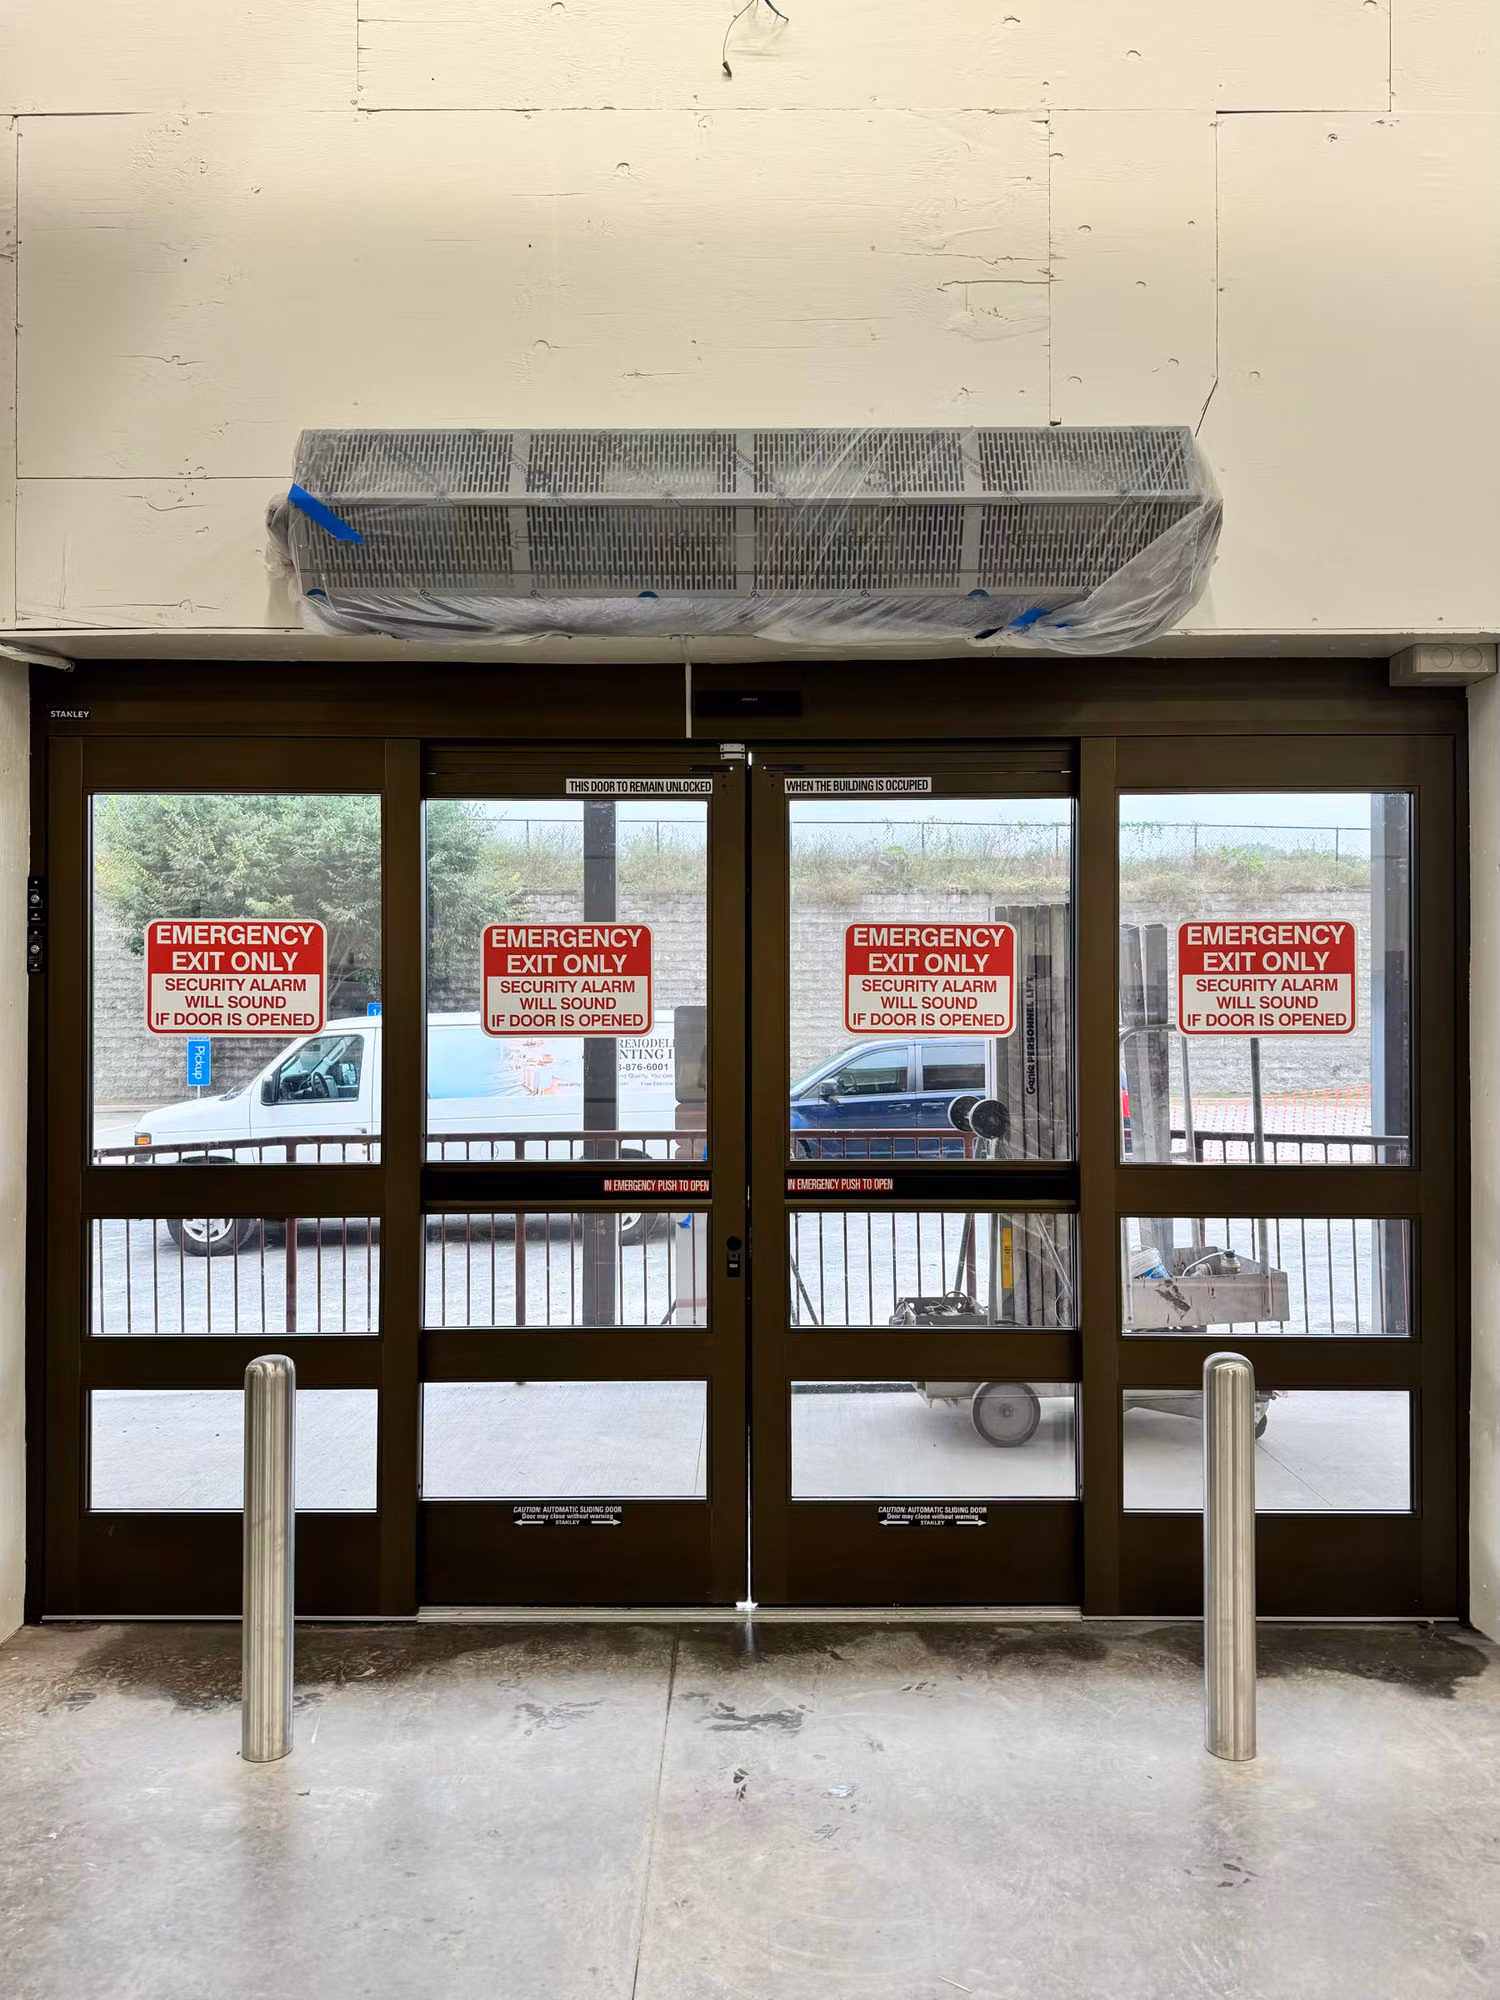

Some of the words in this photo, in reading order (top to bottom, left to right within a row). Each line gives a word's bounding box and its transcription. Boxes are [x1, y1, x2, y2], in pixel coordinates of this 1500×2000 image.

[50, 710, 90, 718] STANLEY
[569, 781, 589, 792] THIS
[591, 781, 615, 792] DOOR
[617, 781, 628, 792] TO
[630, 781, 665, 792] REMAIN
[666, 781, 712, 792] UNLOCKED
[786, 781, 813, 792] WHEN
[815, 780, 832, 791] THE
[833, 780, 874, 791] BUILDING
[875, 780, 884, 791] IS
[885, 779, 928, 790] OCCUPIED
[157, 925, 314, 945] EMERGENCY
[492, 929, 642, 947] EMERGENCY
[854, 928, 1004, 947] EMERGENCY
[1188, 925, 1345, 945] EMERGENCY
[173, 952, 224, 970] EXIT
[231, 952, 298, 971] ONLY
[508, 955, 557, 973] EXIT
[564, 954, 627, 973] ONLY
[869, 953, 919, 972] EXIT
[925, 954, 989, 972] ONLY
[1204, 952, 1256, 971] EXIT
[1263, 952, 1329, 971] ONLY
[165, 978, 245, 991] SECURITY
[249, 979, 306, 991] ALARM
[501, 981, 577, 993] SECURITY
[581, 980, 635, 993] ALARM
[862, 979, 938, 992] SECURITY
[942, 980, 996, 992] ALARM
[1197, 979, 1277, 992] SECURITY
[1281, 979, 1337, 991] ALARM
[185, 996, 224, 1008] WILL
[228, 996, 286, 1008] SOUND
[520, 998, 557, 1010] WILL
[561, 997, 616, 1010] SOUND
[881, 997, 918, 1009] WILL
[922, 997, 977, 1009] SOUND
[1216, 996, 1256, 1009] WILL
[1260, 996, 1318, 1009] SOUND
[156, 1013, 169, 1025] IF
[174, 1013, 222, 1025] DOOR
[228, 1013, 242, 1026] IS
[247, 1013, 314, 1026] OPENED
[492, 1015, 505, 1027] IF
[510, 1014, 555, 1027] DOOR
[561, 1014, 574, 1026] IS
[579, 1014, 643, 1026] OPENED
[853, 1013, 866, 1025] IF
[871, 1013, 916, 1025] DOOR
[921, 1013, 935, 1026] IS
[940, 1014, 1004, 1026] OPENED
[1188, 1014, 1201, 1026] IF
[1206, 1014, 1254, 1026] DOOR
[1260, 1013, 1274, 1026] IS
[1279, 1013, 1346, 1026] OPENED
[1026, 1002, 1035, 1062] PERSONNEL
[191, 1045, 206, 1080] Pickup
[604, 1180, 611, 1191] IN
[614, 1180, 656, 1191] EMERGENCY
[658, 1180, 677, 1191] PUSH
[679, 1180, 688, 1191] TO
[691, 1180, 709, 1191] OPEN
[787, 1179, 795, 1189] IN
[798, 1179, 839, 1190] EMERGENCY
[841, 1179, 860, 1190] PUSH
[863, 1179, 872, 1190] TO
[874, 1179, 893, 1190] OPEN
